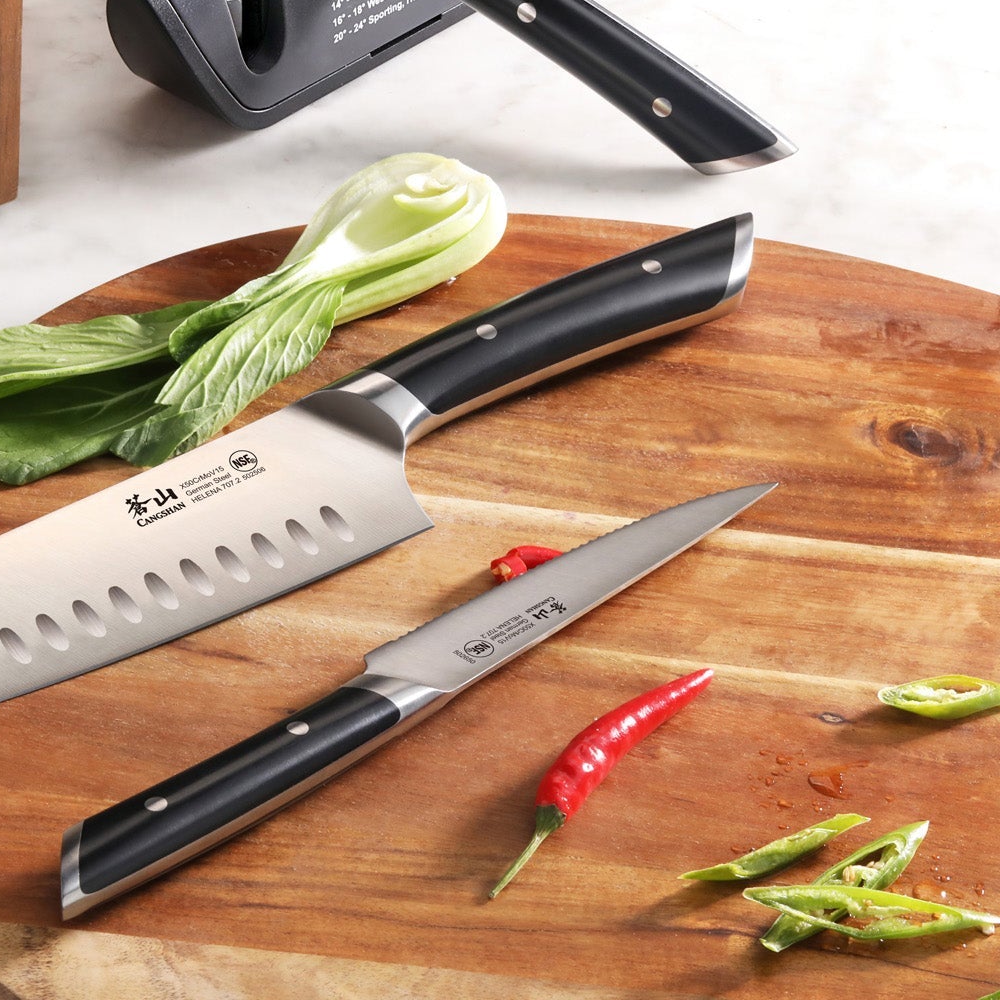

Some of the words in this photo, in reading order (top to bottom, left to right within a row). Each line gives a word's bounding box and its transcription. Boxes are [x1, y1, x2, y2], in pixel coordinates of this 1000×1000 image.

[332, 13, 346, 27] 16°
[353, 2, 366, 17] 18°
[333, 29, 347, 44] 20°
[353, 18, 367, 33] 24°
[368, 0, 405, 25] Sporting,
[179, 465, 225, 490] X50CrMoV15
[185, 481, 214, 497] German
[213, 472, 232, 484] Steel
[191, 486, 222, 504] HELENA
[136, 501, 187, 528] CANGSHAN
[498, 614, 522, 630] HELENA
[505, 618, 529, 633] German
